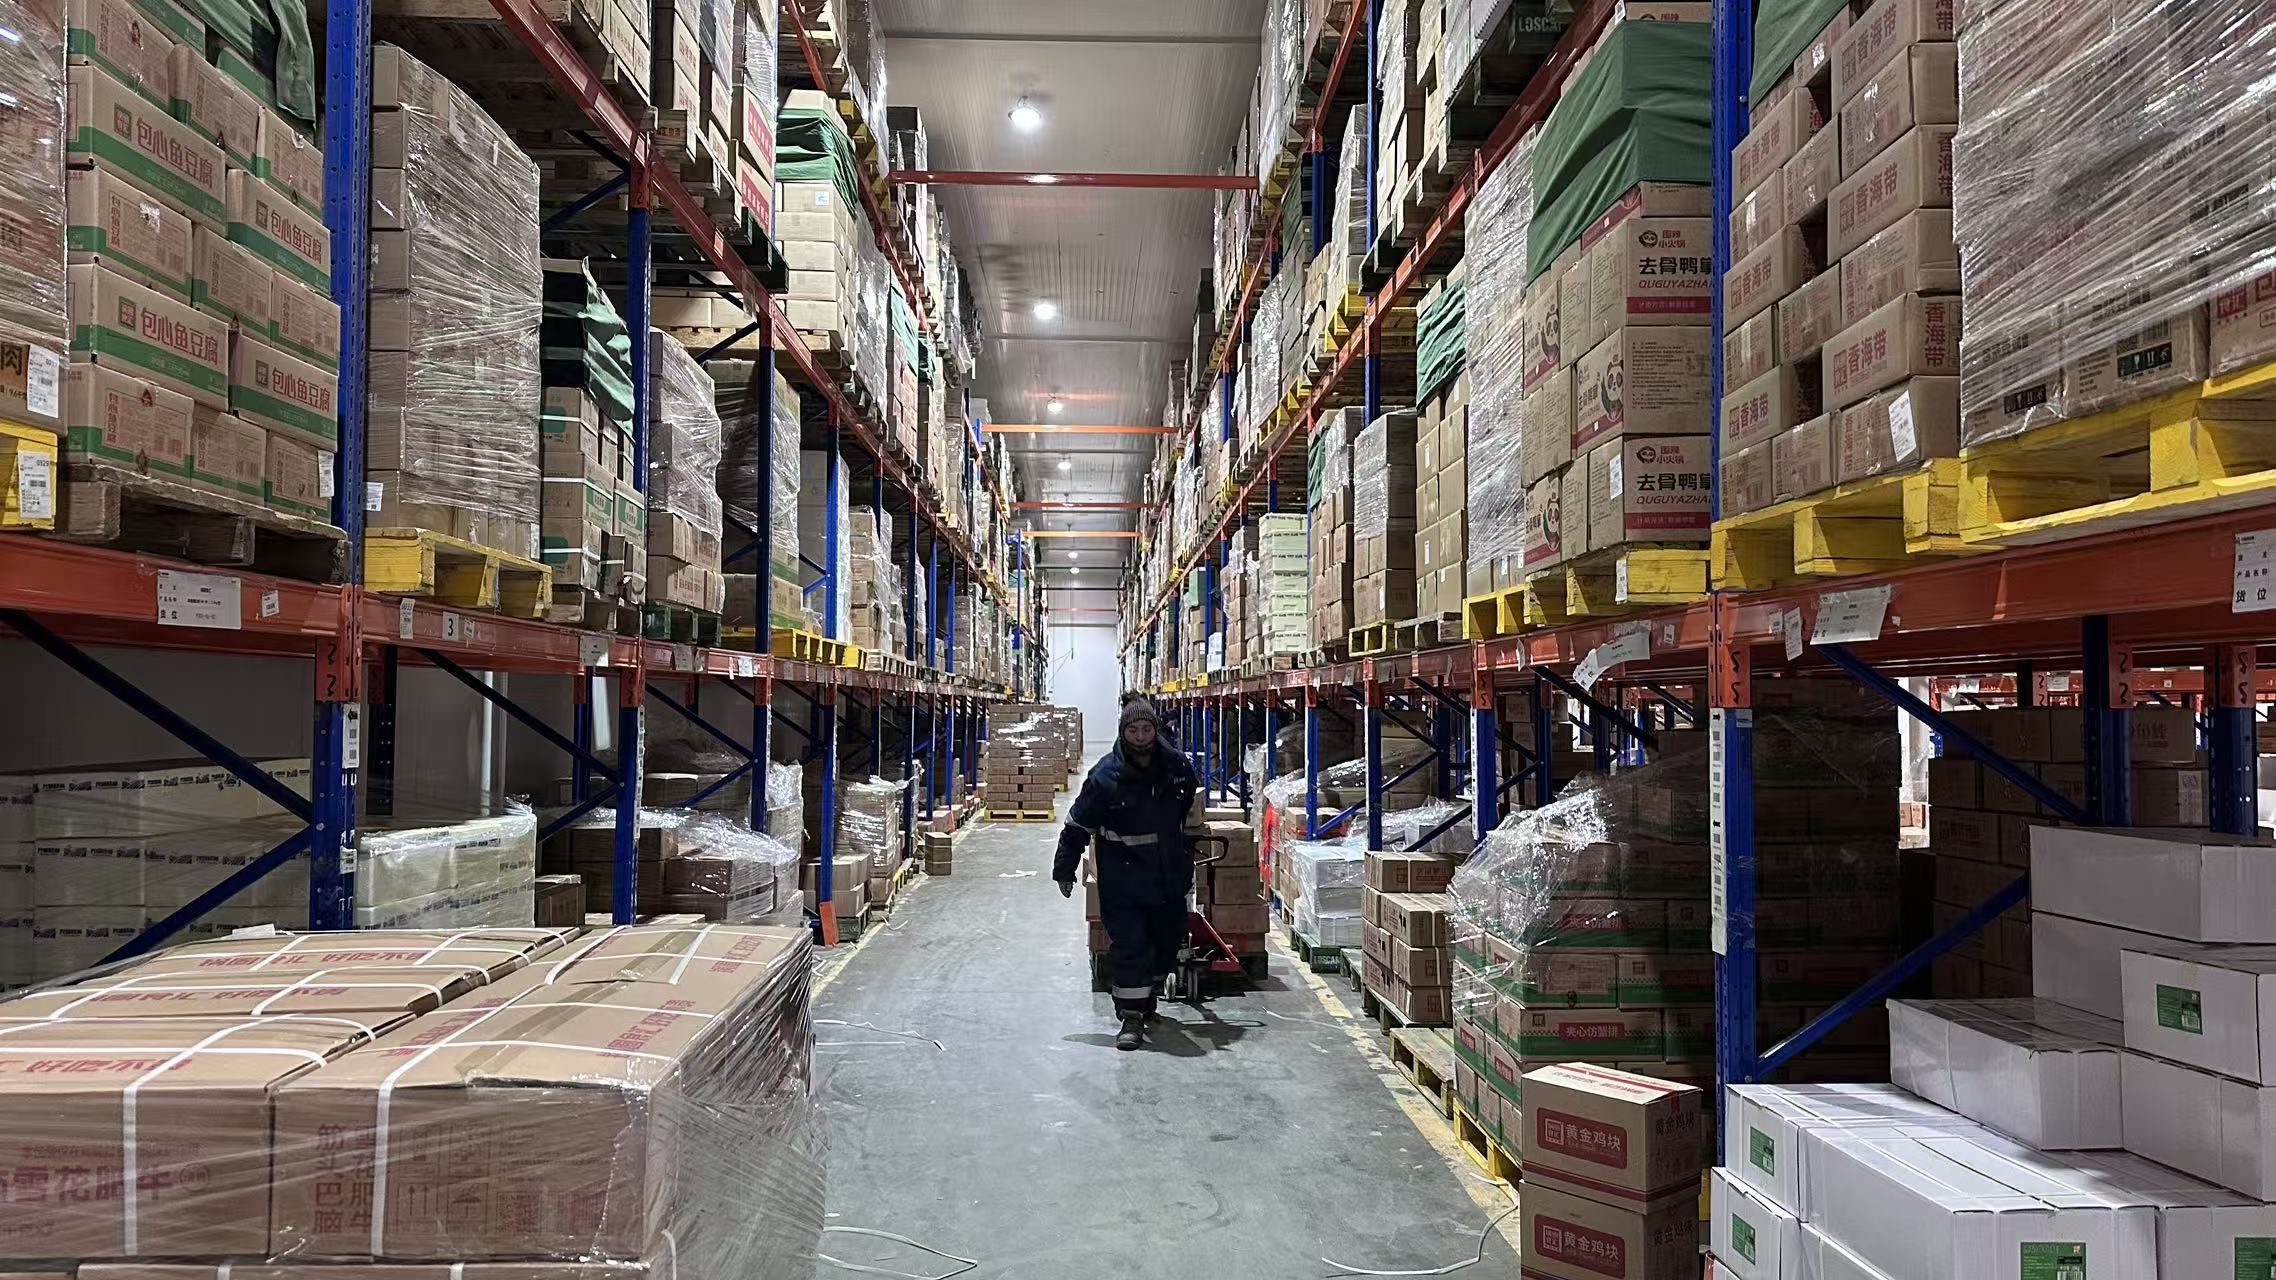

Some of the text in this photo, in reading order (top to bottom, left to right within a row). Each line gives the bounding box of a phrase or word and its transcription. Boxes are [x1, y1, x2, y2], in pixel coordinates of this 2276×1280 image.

[1857, 3, 1897, 60] 香海带
[137, 117, 214, 189] 包心鱼豆腐
[1751, 125, 1781, 163] 香海带
[1856, 163, 1898, 211] 香海带
[270, 208, 322, 264] 包心鱼豆腐
[1742, 256, 1771, 294] 香海带
[140, 306, 219, 366] 包心鱼豆腐
[1848, 328, 1887, 375] 香海带
[1925, 302, 1946, 367] 香海带
[1, 342, 22, 376] 肉
[272, 368, 330, 414] 包心鱼豆腐
[1740, 391, 1769, 428] 香海带
[447, 617, 454, 637] 3
[1565, 1122, 1621, 1151] 黄金鸡块
[1563, 1231, 1619, 1260] 黄金鸡块
